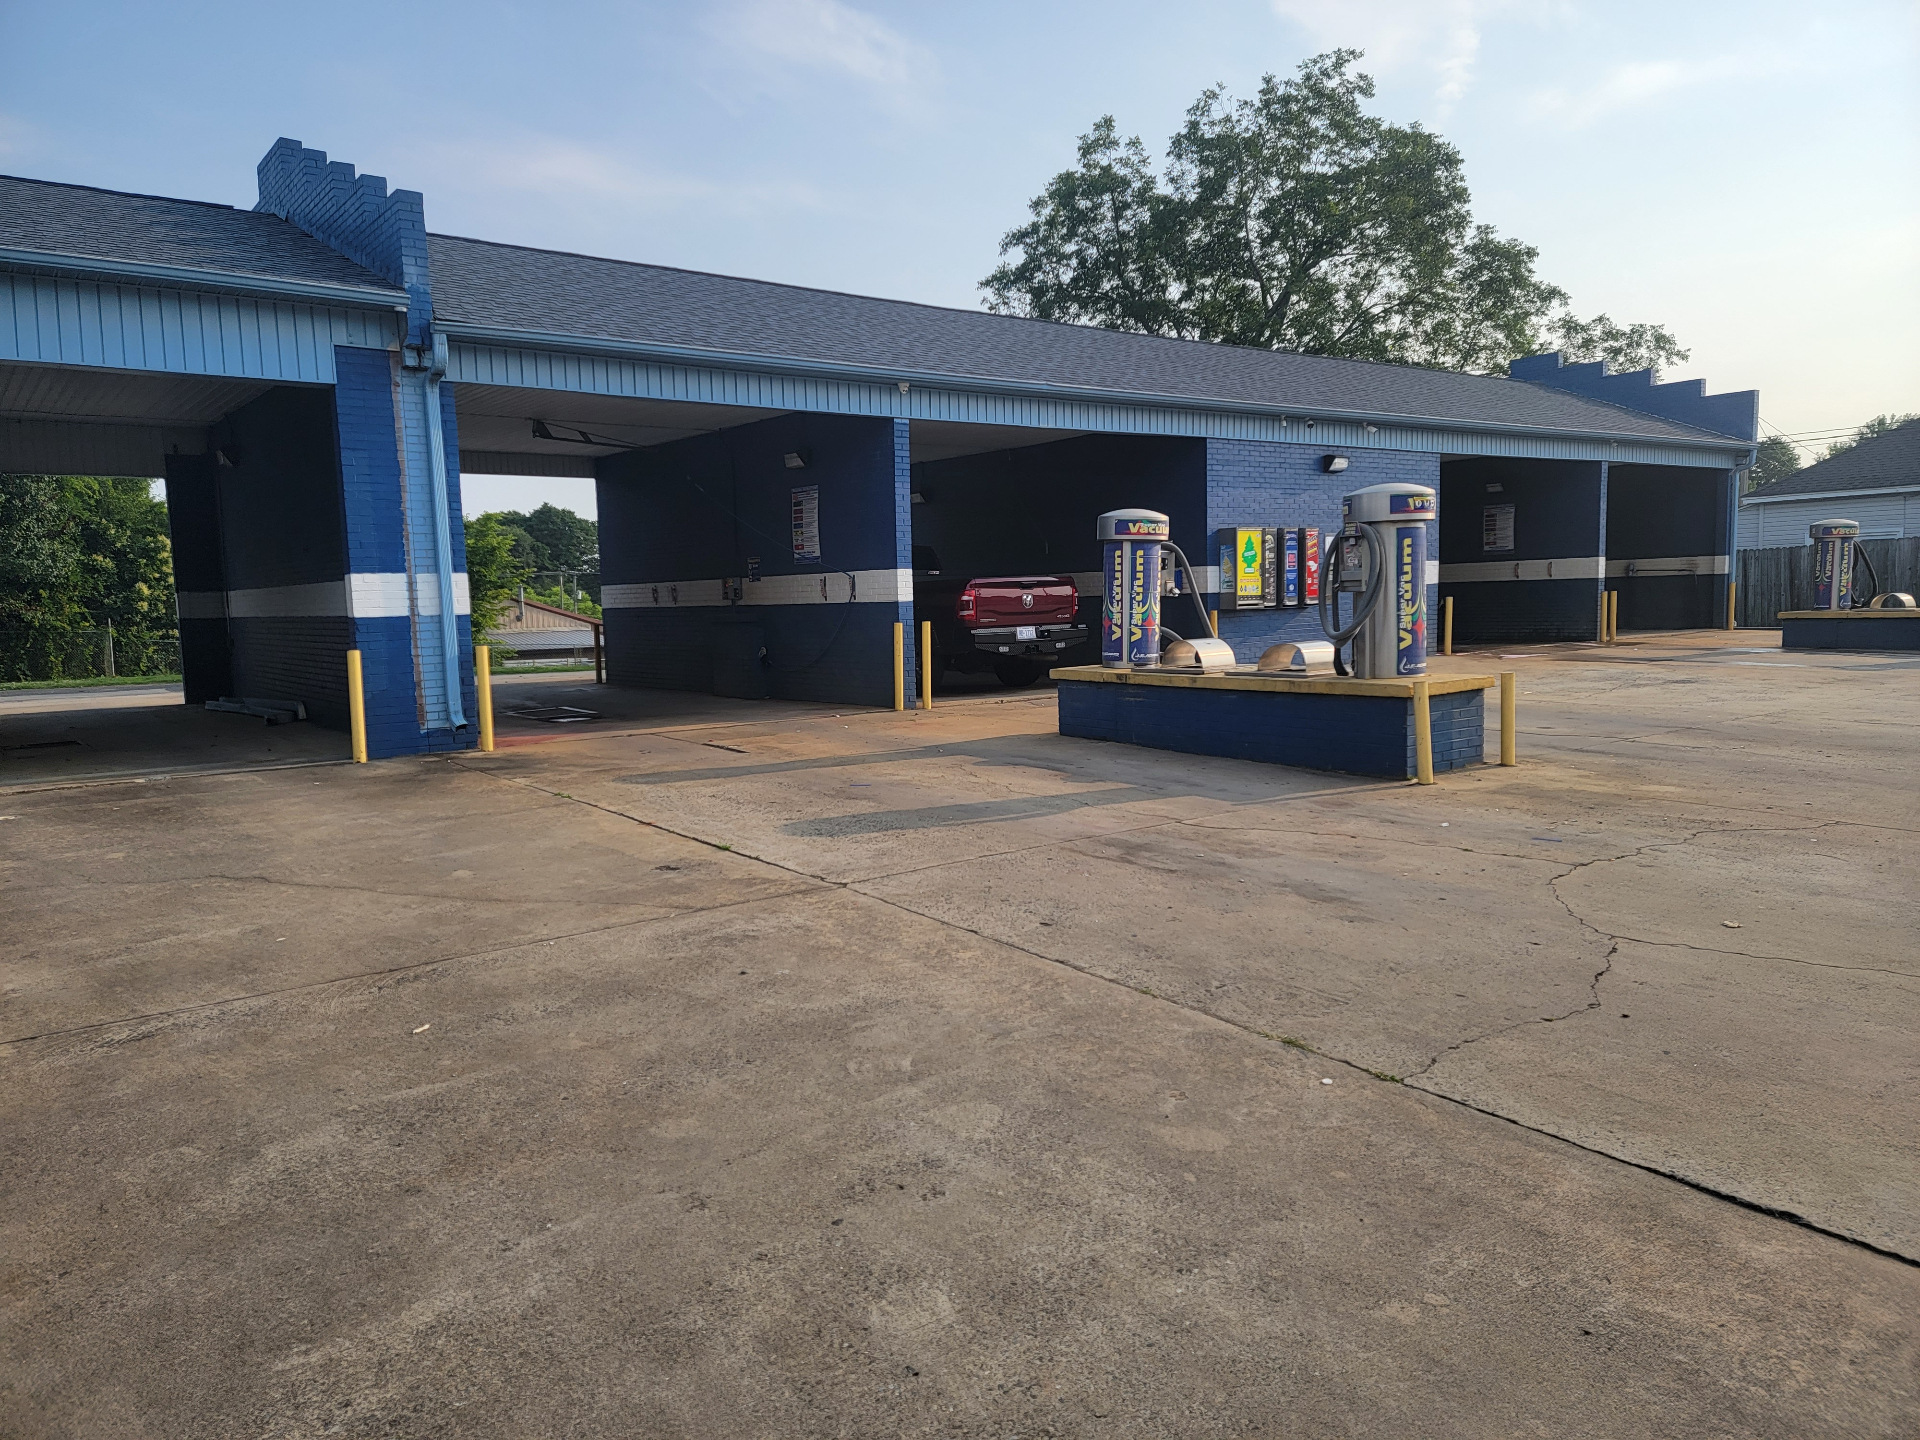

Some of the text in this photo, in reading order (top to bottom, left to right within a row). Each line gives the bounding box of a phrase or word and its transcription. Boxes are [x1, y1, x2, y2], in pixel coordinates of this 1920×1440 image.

[1128, 522, 1169, 534] Vacuu
[1111, 550, 1122, 641] Vacuum
[1131, 549, 1144, 642] Vacuum
[1399, 537, 1412, 650] Vacuum
